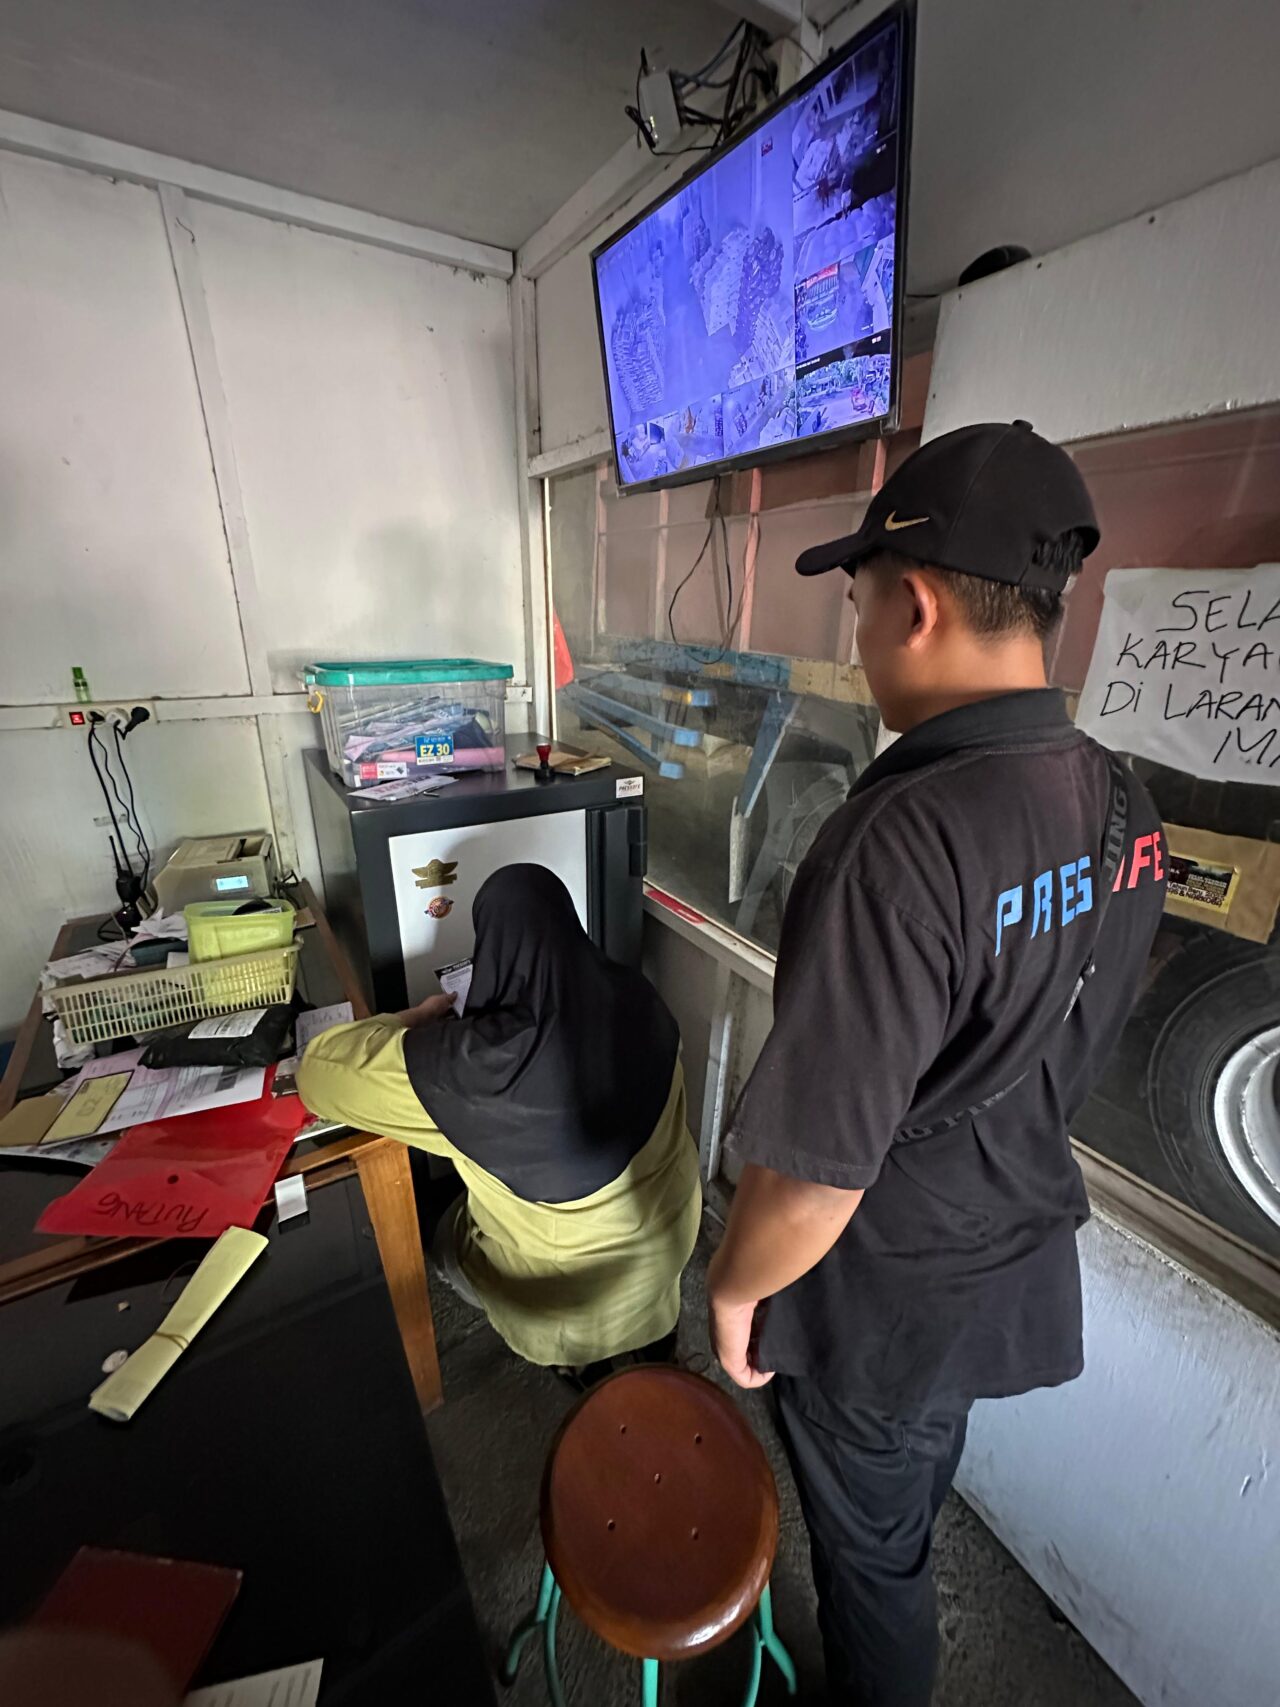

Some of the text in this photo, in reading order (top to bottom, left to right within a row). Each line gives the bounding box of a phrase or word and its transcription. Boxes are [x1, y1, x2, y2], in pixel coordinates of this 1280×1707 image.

[1116, 632, 1280, 684] KARYA
[420, 743, 450, 757] EZ 30
